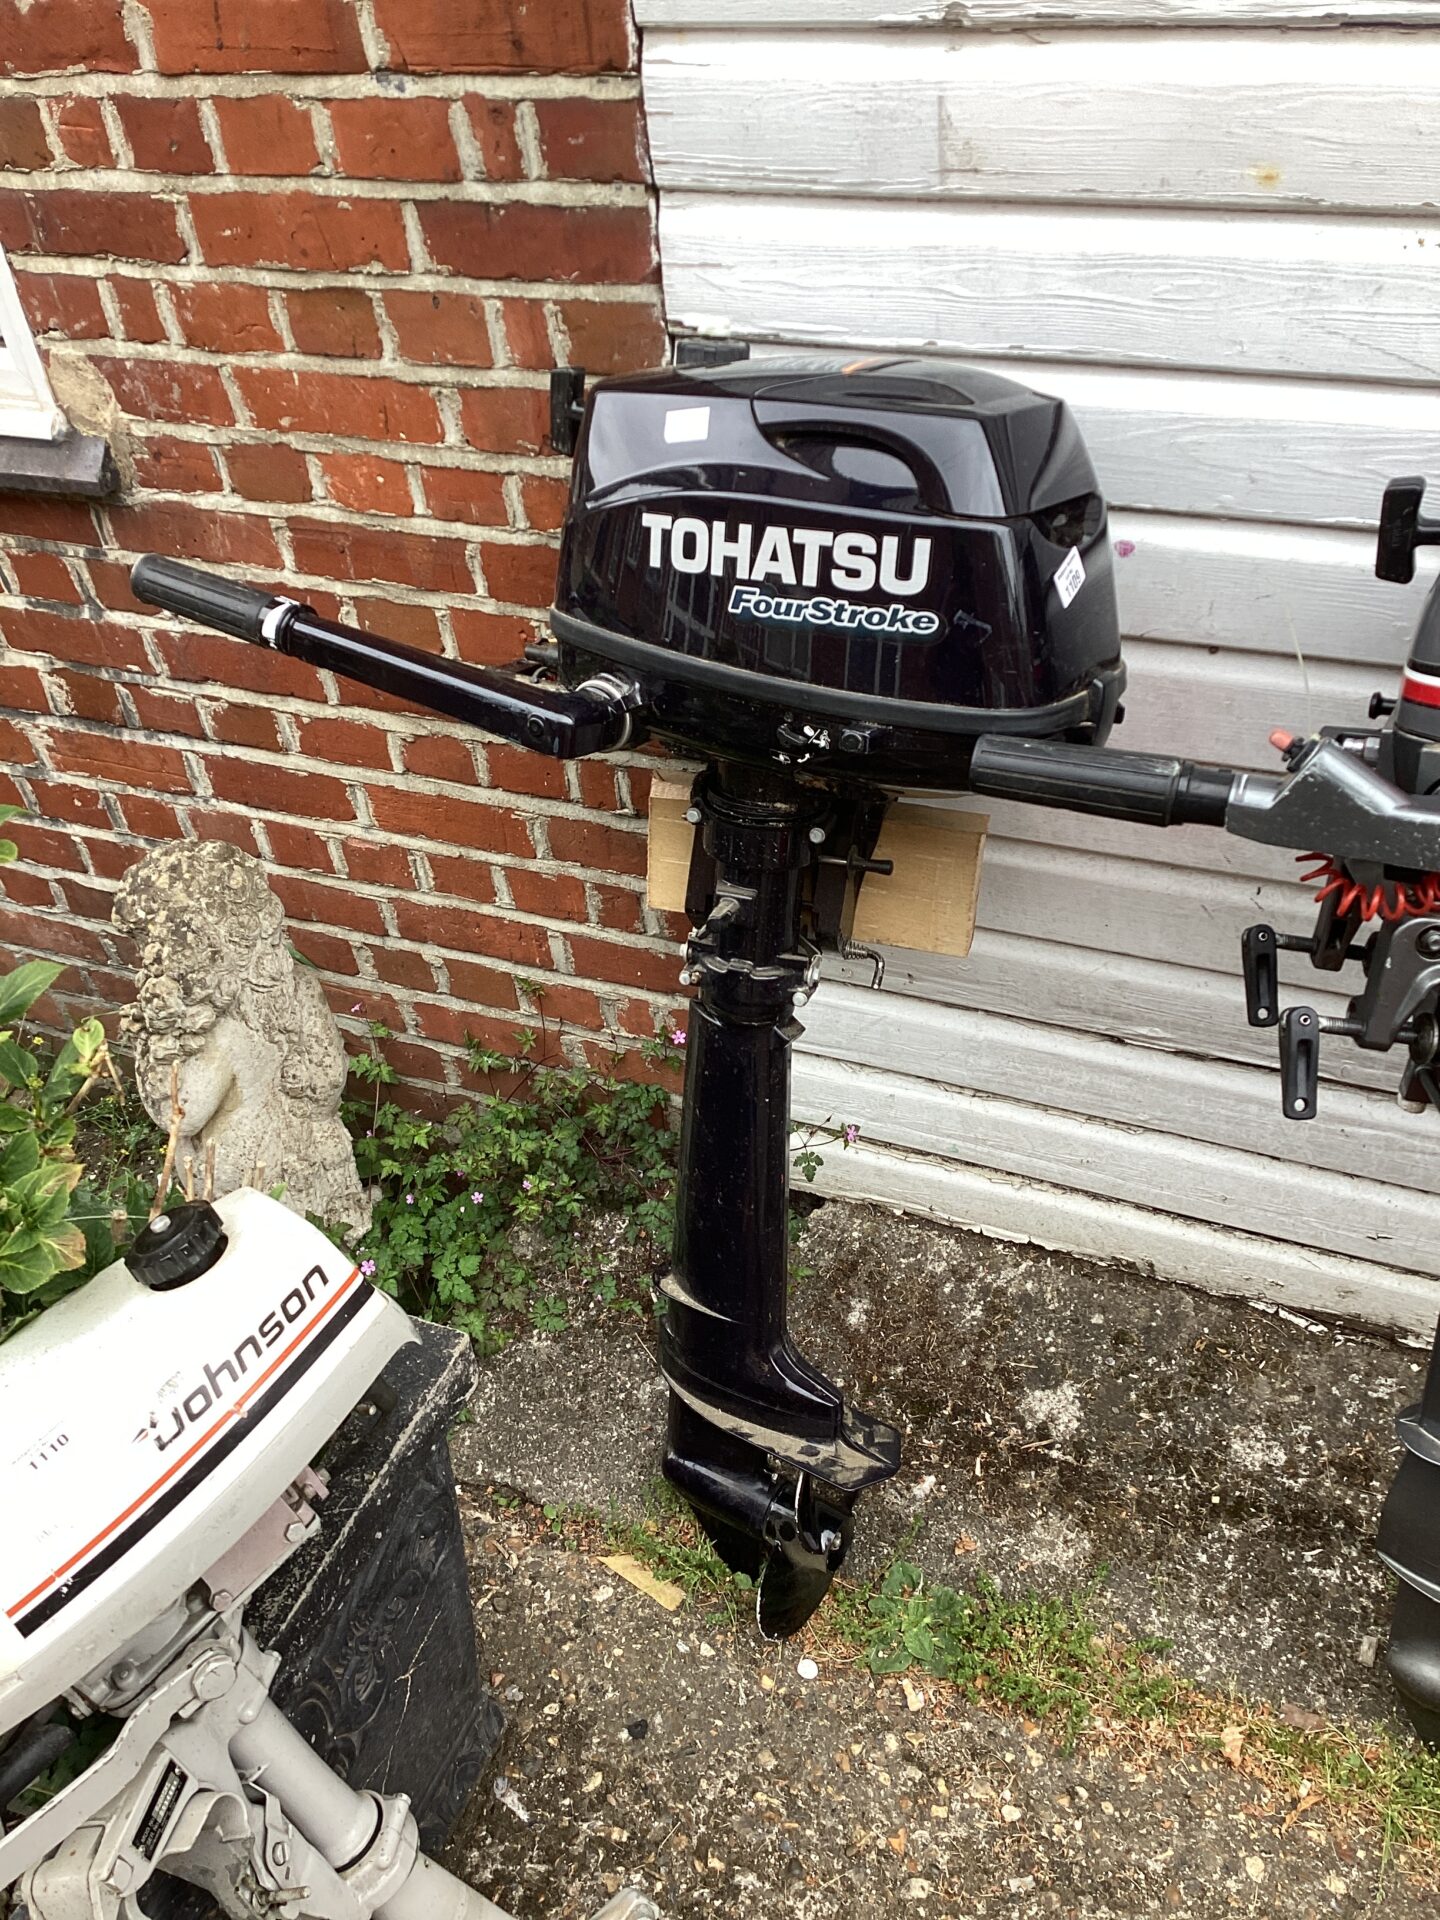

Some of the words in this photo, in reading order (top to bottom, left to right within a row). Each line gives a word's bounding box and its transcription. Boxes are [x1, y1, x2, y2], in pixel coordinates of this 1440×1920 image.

[641, 512, 932, 597] TOHATSU
[728, 584, 940, 635] FourStroke
[151, 1264, 329, 1452] Johnson
